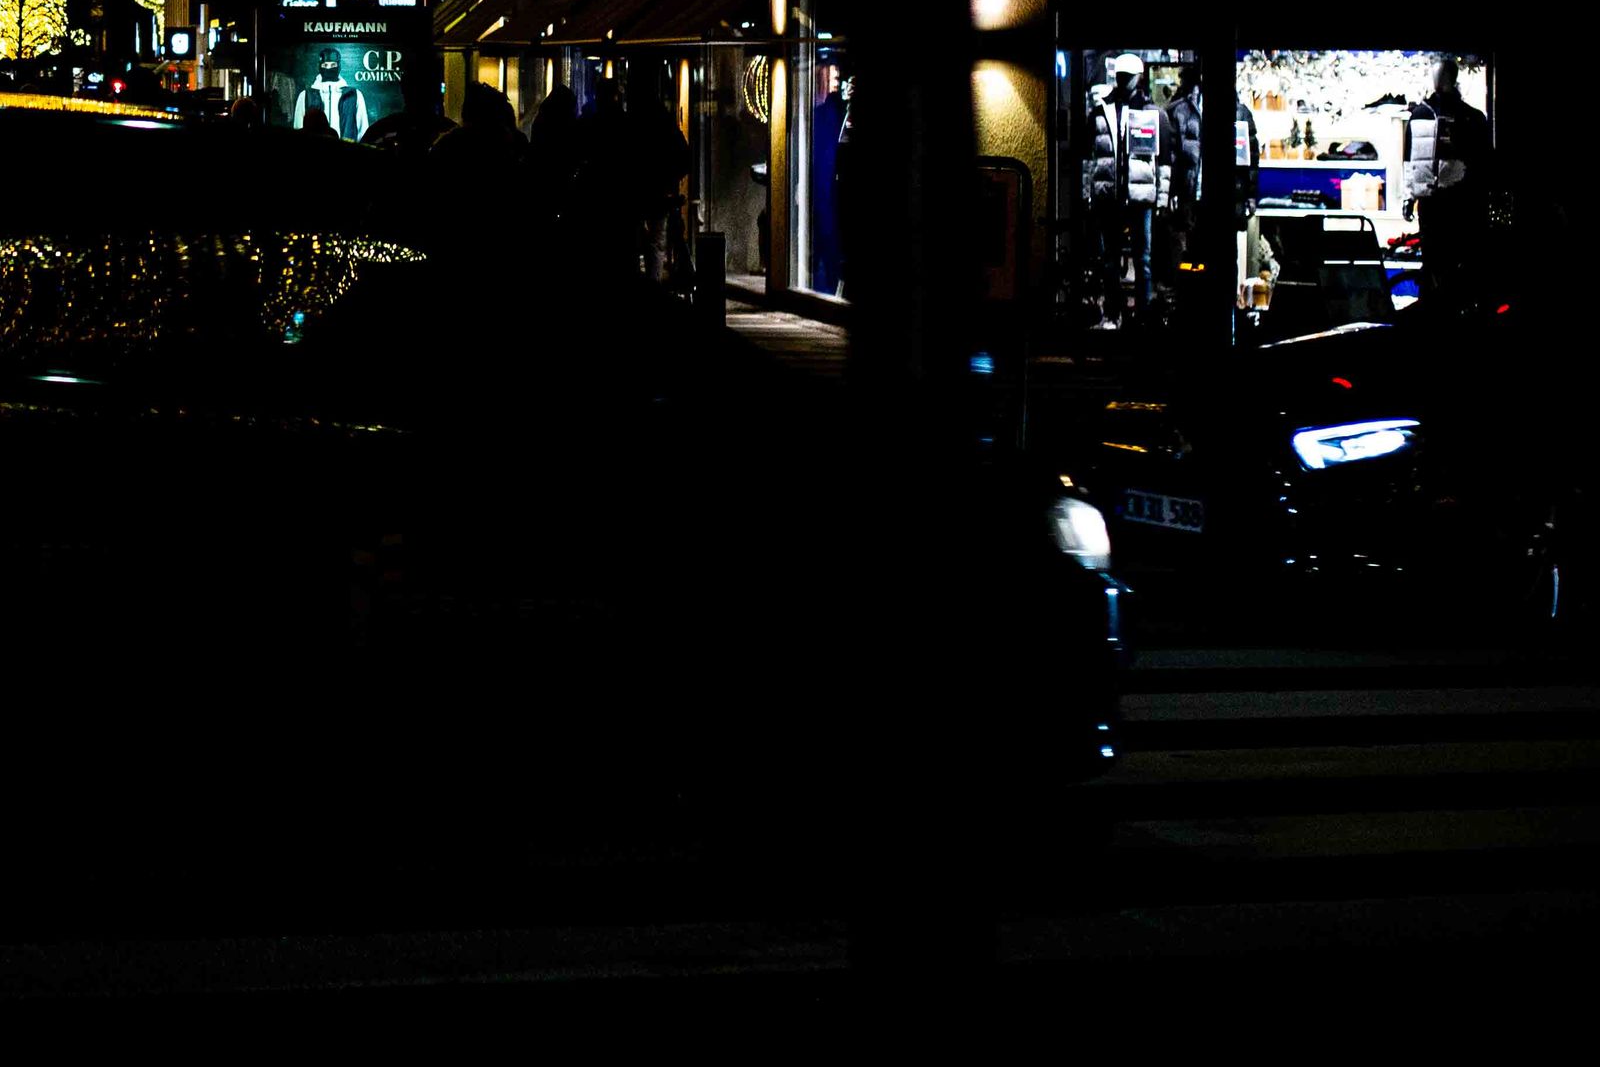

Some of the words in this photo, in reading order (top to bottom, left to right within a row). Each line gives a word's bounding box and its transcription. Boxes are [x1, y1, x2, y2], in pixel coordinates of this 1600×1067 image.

[303, 21, 388, 34] KAUFMANN
[362, 49, 402, 72] C.P.
[354, 71, 404, 83] COMPAN
